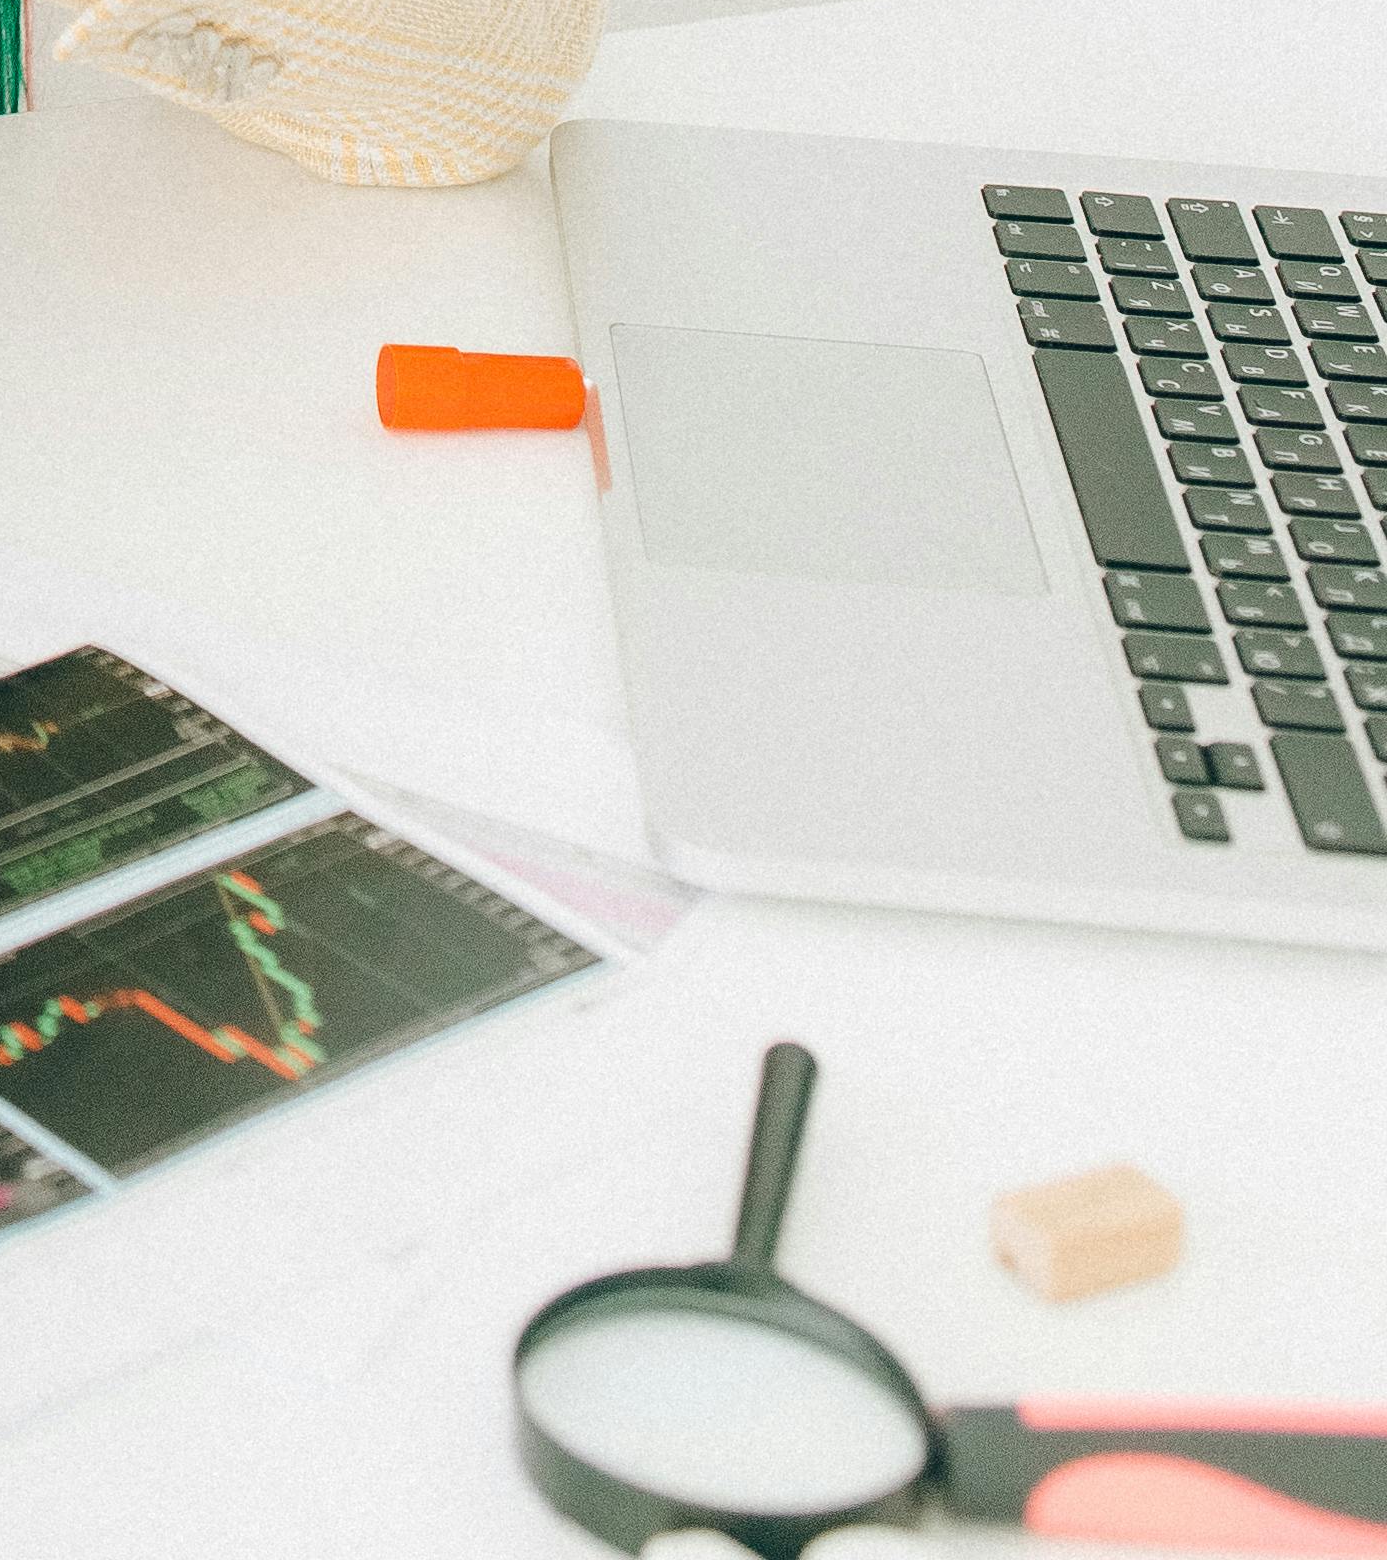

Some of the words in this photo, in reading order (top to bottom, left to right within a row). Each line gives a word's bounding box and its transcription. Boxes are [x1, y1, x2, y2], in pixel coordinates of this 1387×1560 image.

[1235, 269, 1256, 278] A
[1320, 267, 1341, 276] Q
[1152, 282, 1175, 291] Z
[1211, 283, 1231, 293] Ф
[1296, 281, 1323, 290] Й
[1130, 299, 1151, 307] Я
[1337, 306, 1360, 317] W
[1167, 322, 1189, 331] X
[1225, 324, 1249, 334] Ы
[1265, 349, 1288, 358] D
[1182, 363, 1205, 372] C
[1242, 366, 1264, 374] В
[1329, 363, 1353, 372] У
[1282, 391, 1305, 399] F
[1198, 406, 1221, 415] V
[1257, 408, 1280, 417] А
[1347, 404, 1370, 413] К
[1171, 419, 1195, 431] М
[1299, 434, 1323, 445] G
[1212, 448, 1236, 457] B
[1274, 451, 1299, 461] П
[1187, 466, 1212, 477] И
[1316, 477, 1343, 490] H
[1229, 492, 1255, 505] N
[1333, 523, 1361, 532] J
[1308, 541, 1334, 554] О
[1355, 571, 1378, 582] K
